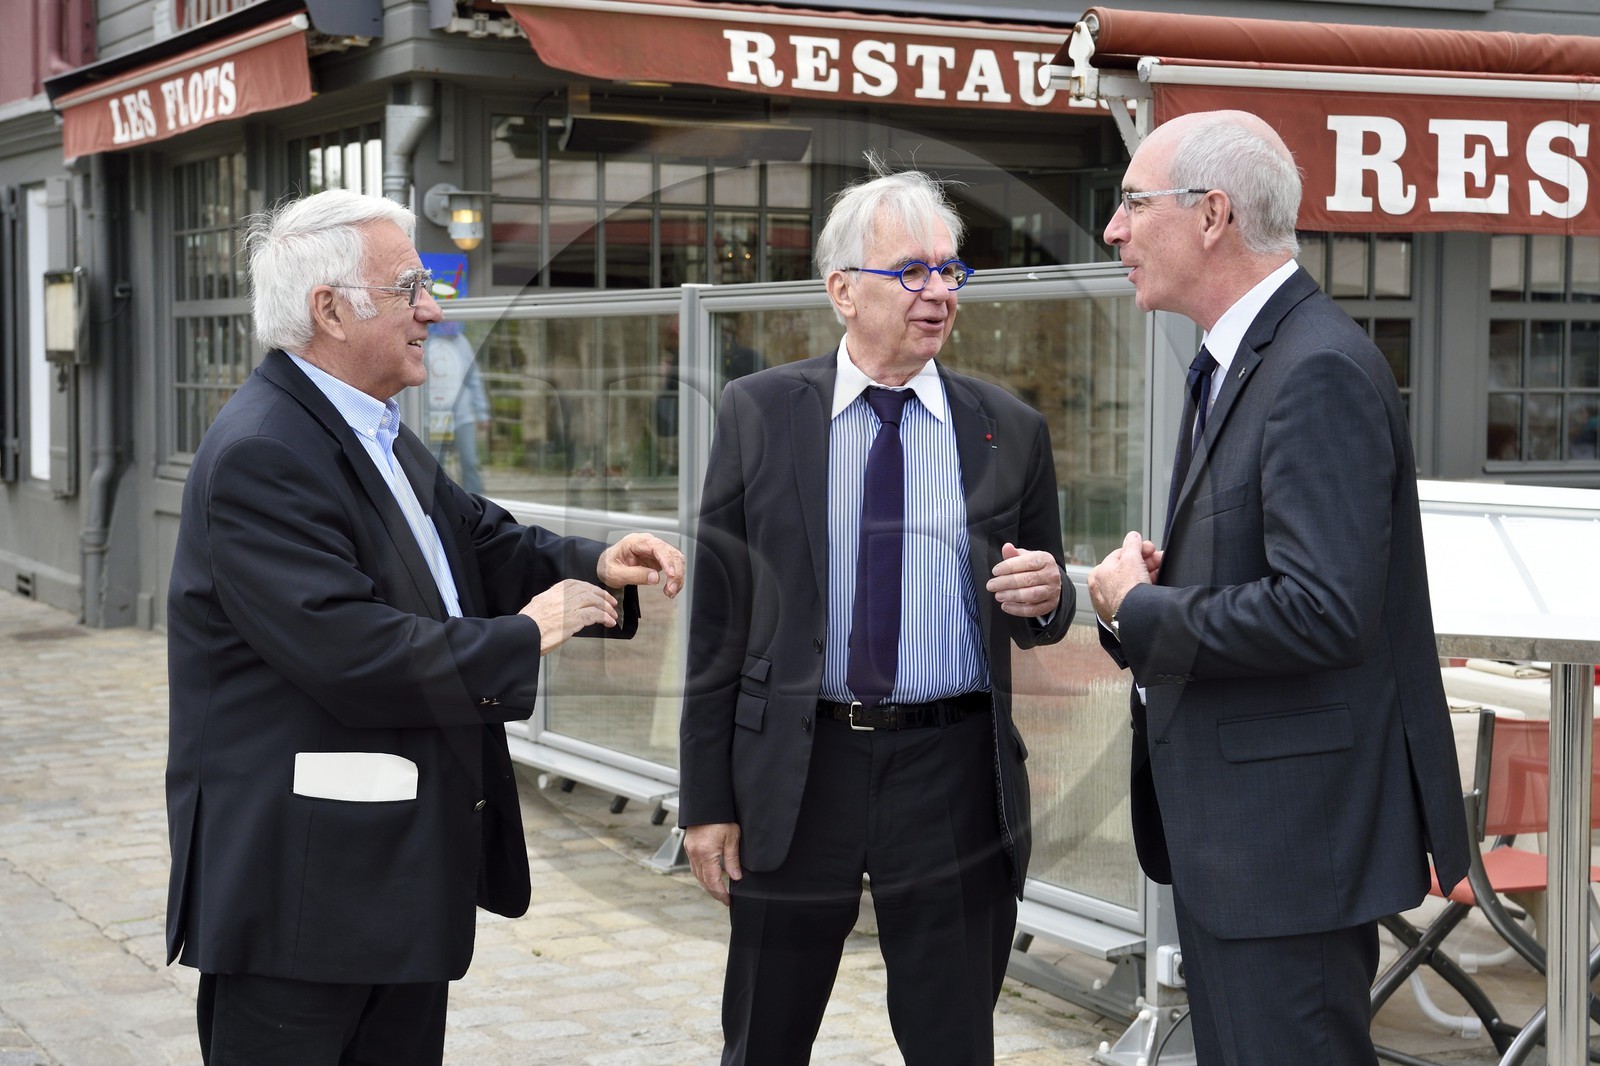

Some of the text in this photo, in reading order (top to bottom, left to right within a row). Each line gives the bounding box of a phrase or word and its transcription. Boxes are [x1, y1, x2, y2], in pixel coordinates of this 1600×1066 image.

[109, 61, 237, 144] LES FLOTS
[722, 29, 1137, 110] RESTAU
[1326, 114, 1590, 219] RES
